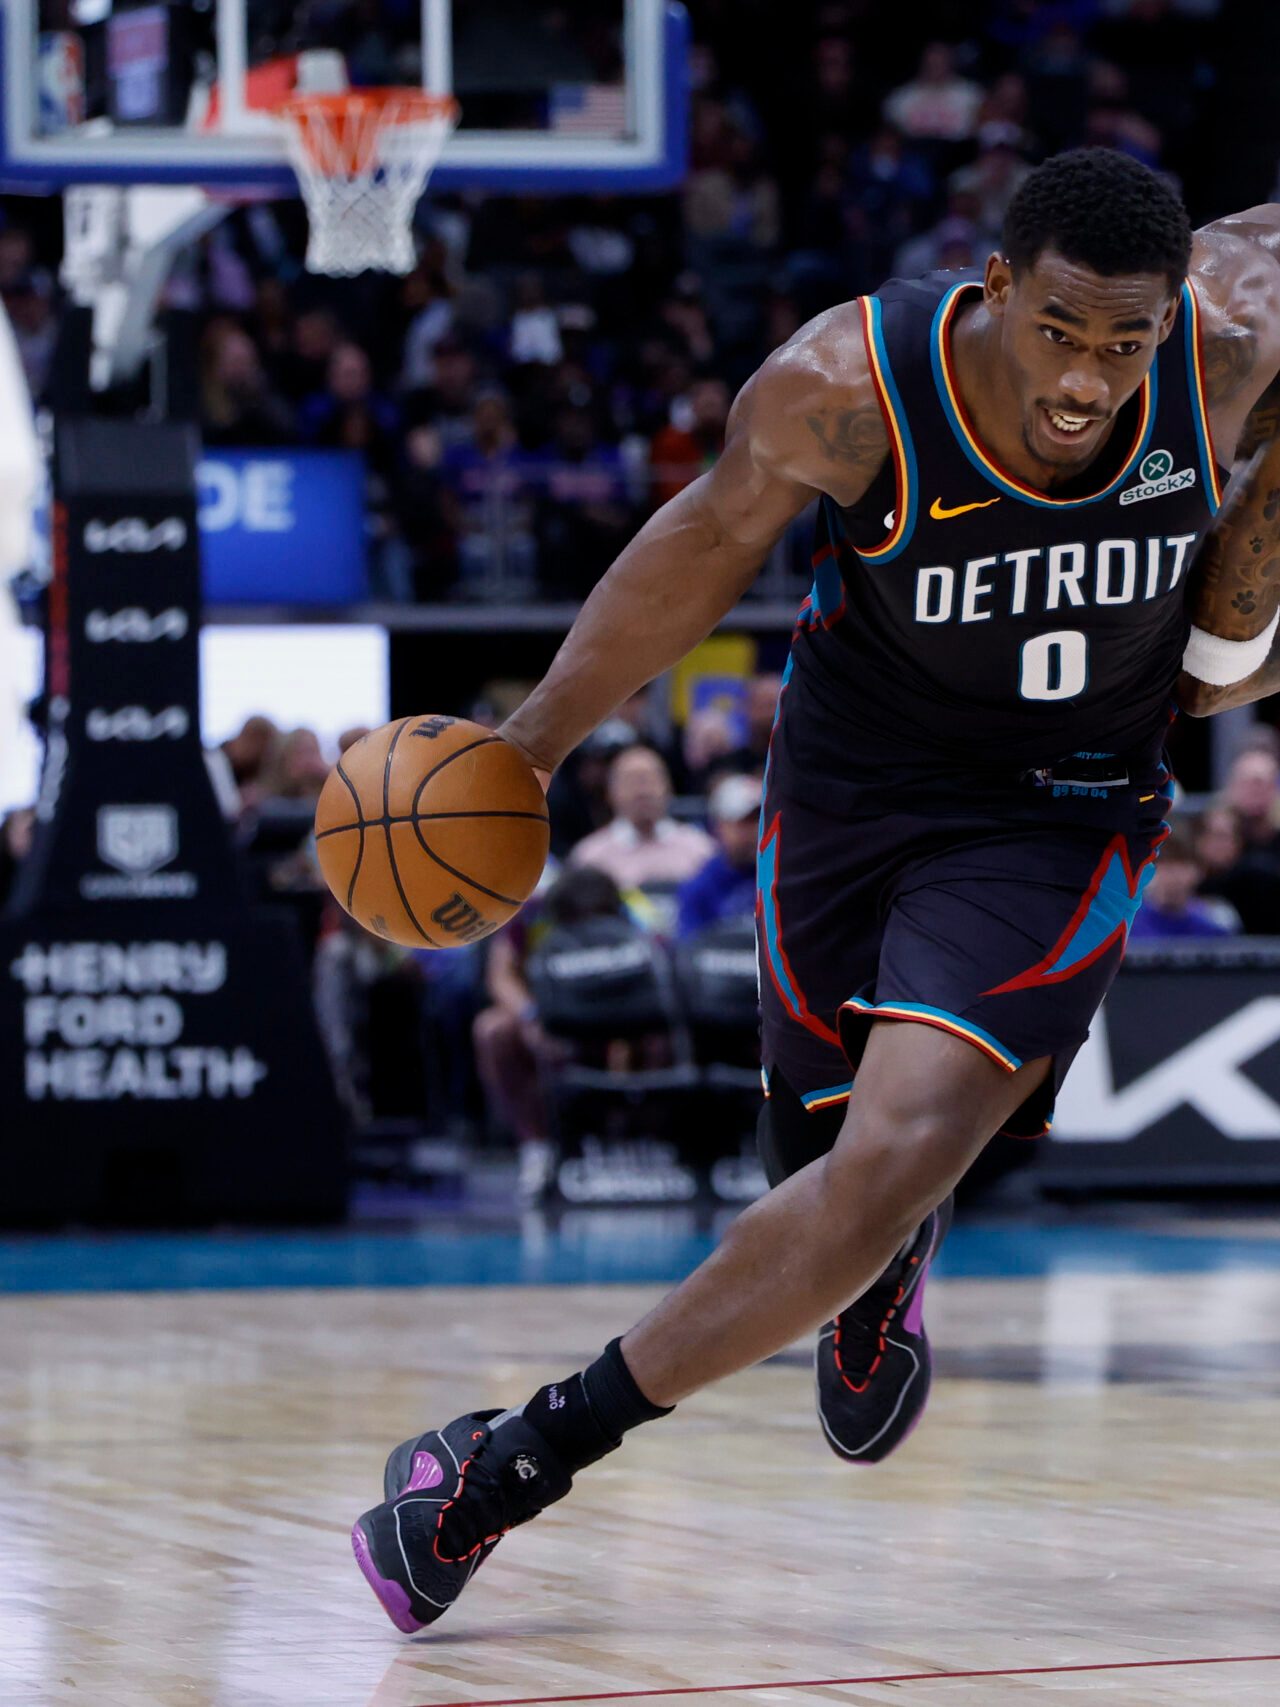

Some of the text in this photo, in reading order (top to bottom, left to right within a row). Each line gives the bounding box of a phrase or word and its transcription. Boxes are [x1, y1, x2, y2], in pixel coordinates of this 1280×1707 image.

[914, 532, 1198, 624] DETROIT
[1018, 630, 1089, 700] 0
[11, 941, 227, 994] HENRY
[24, 995, 183, 1046] FORD
[25, 1046, 267, 1099] HEALTH
